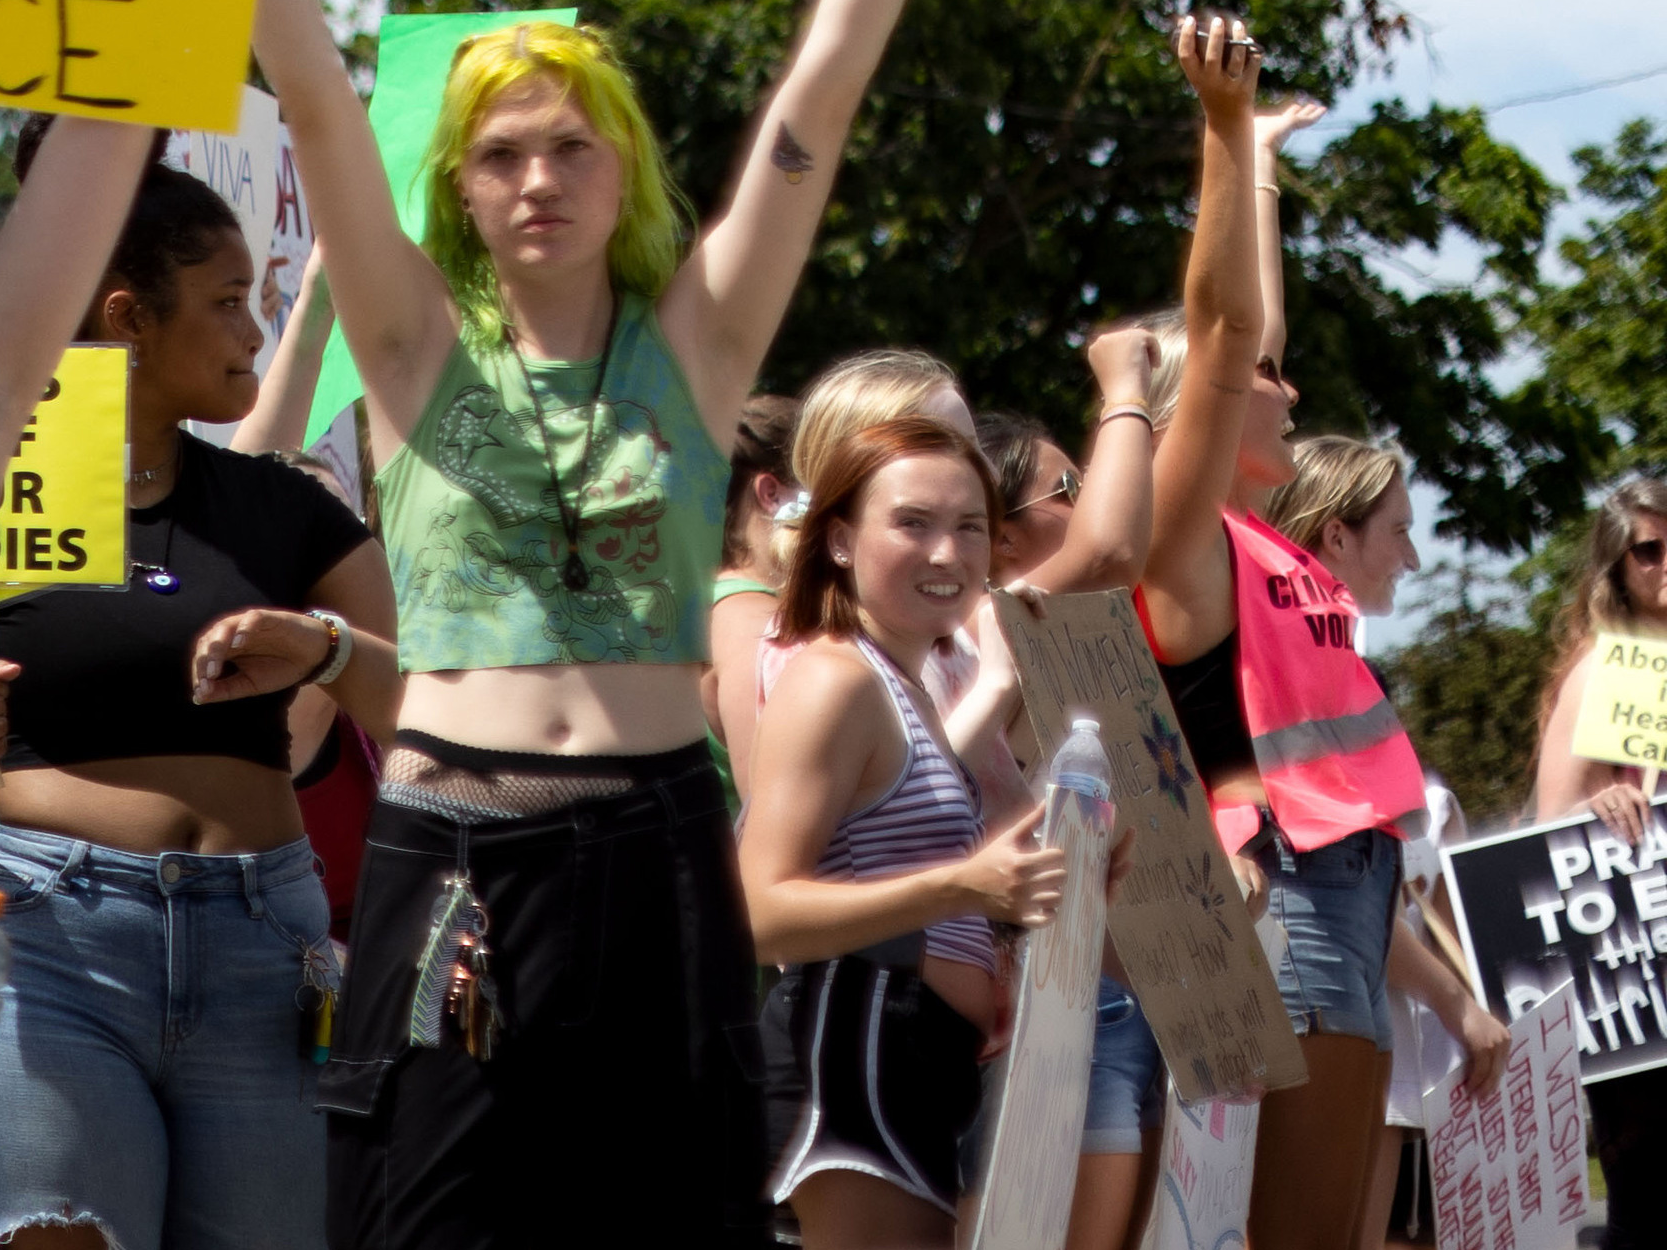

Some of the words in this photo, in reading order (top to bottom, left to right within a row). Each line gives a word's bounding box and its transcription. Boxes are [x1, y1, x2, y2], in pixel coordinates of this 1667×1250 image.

[203, 131, 255, 215] VIVA
[1524, 892, 1616, 945] TO
[1507, 1038, 1538, 1153] UTERUS
[1547, 1046, 1580, 1173] WISH
[1518, 1153, 1542, 1223] SHOT
[1556, 1174, 1586, 1225] MY
